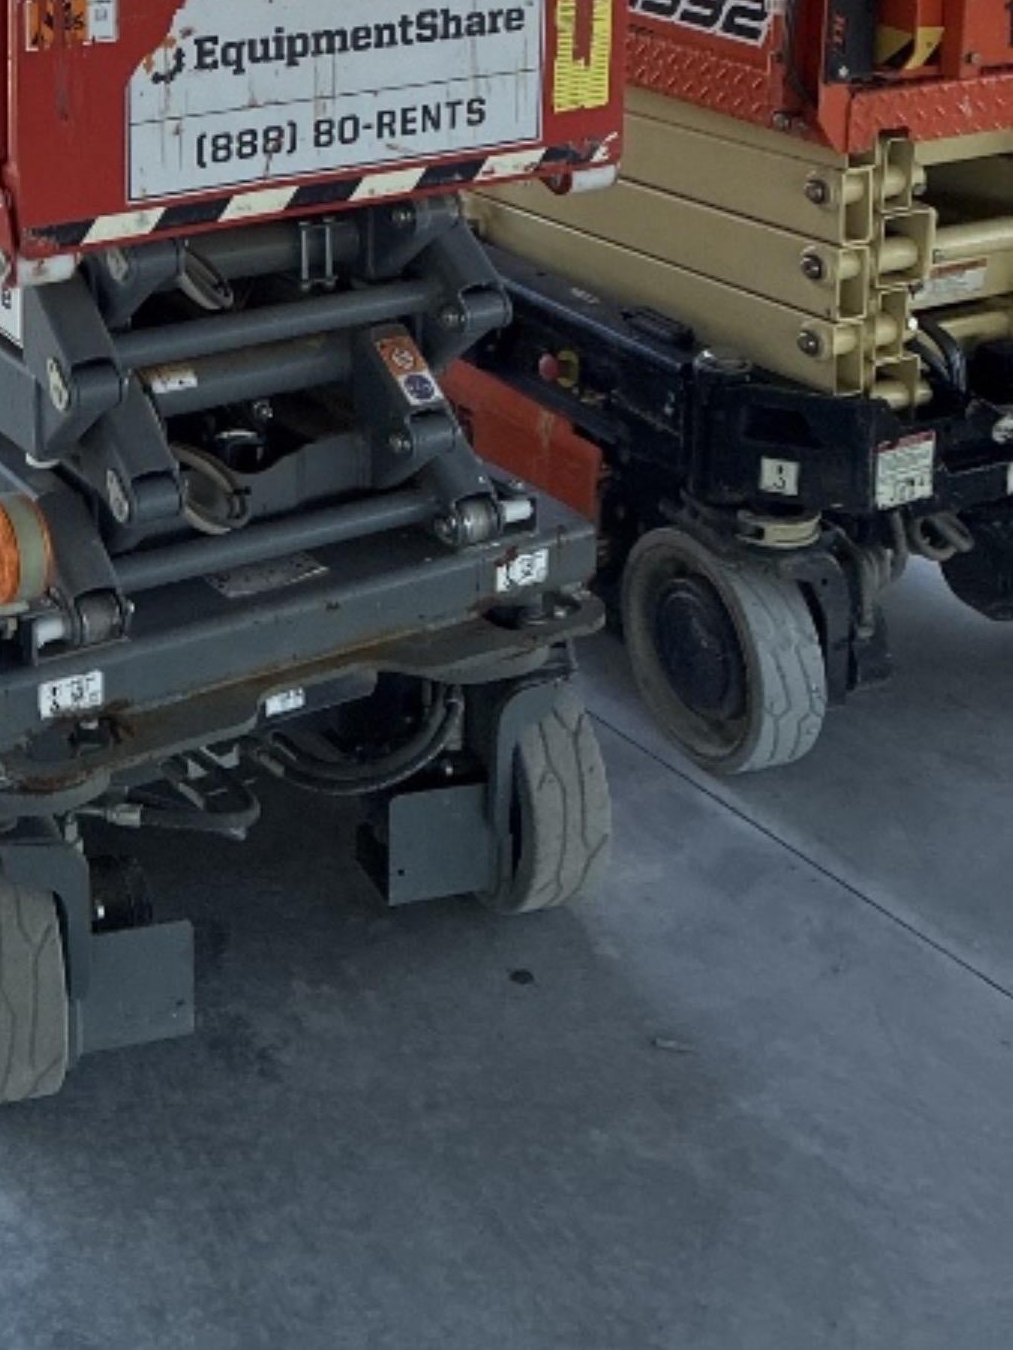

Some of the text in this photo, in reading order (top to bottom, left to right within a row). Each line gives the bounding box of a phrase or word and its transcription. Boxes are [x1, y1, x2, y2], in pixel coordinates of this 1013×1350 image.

[194, 7, 525, 75] EquipmentShare
[196, 97, 487, 169] (888) 80-RENTS
